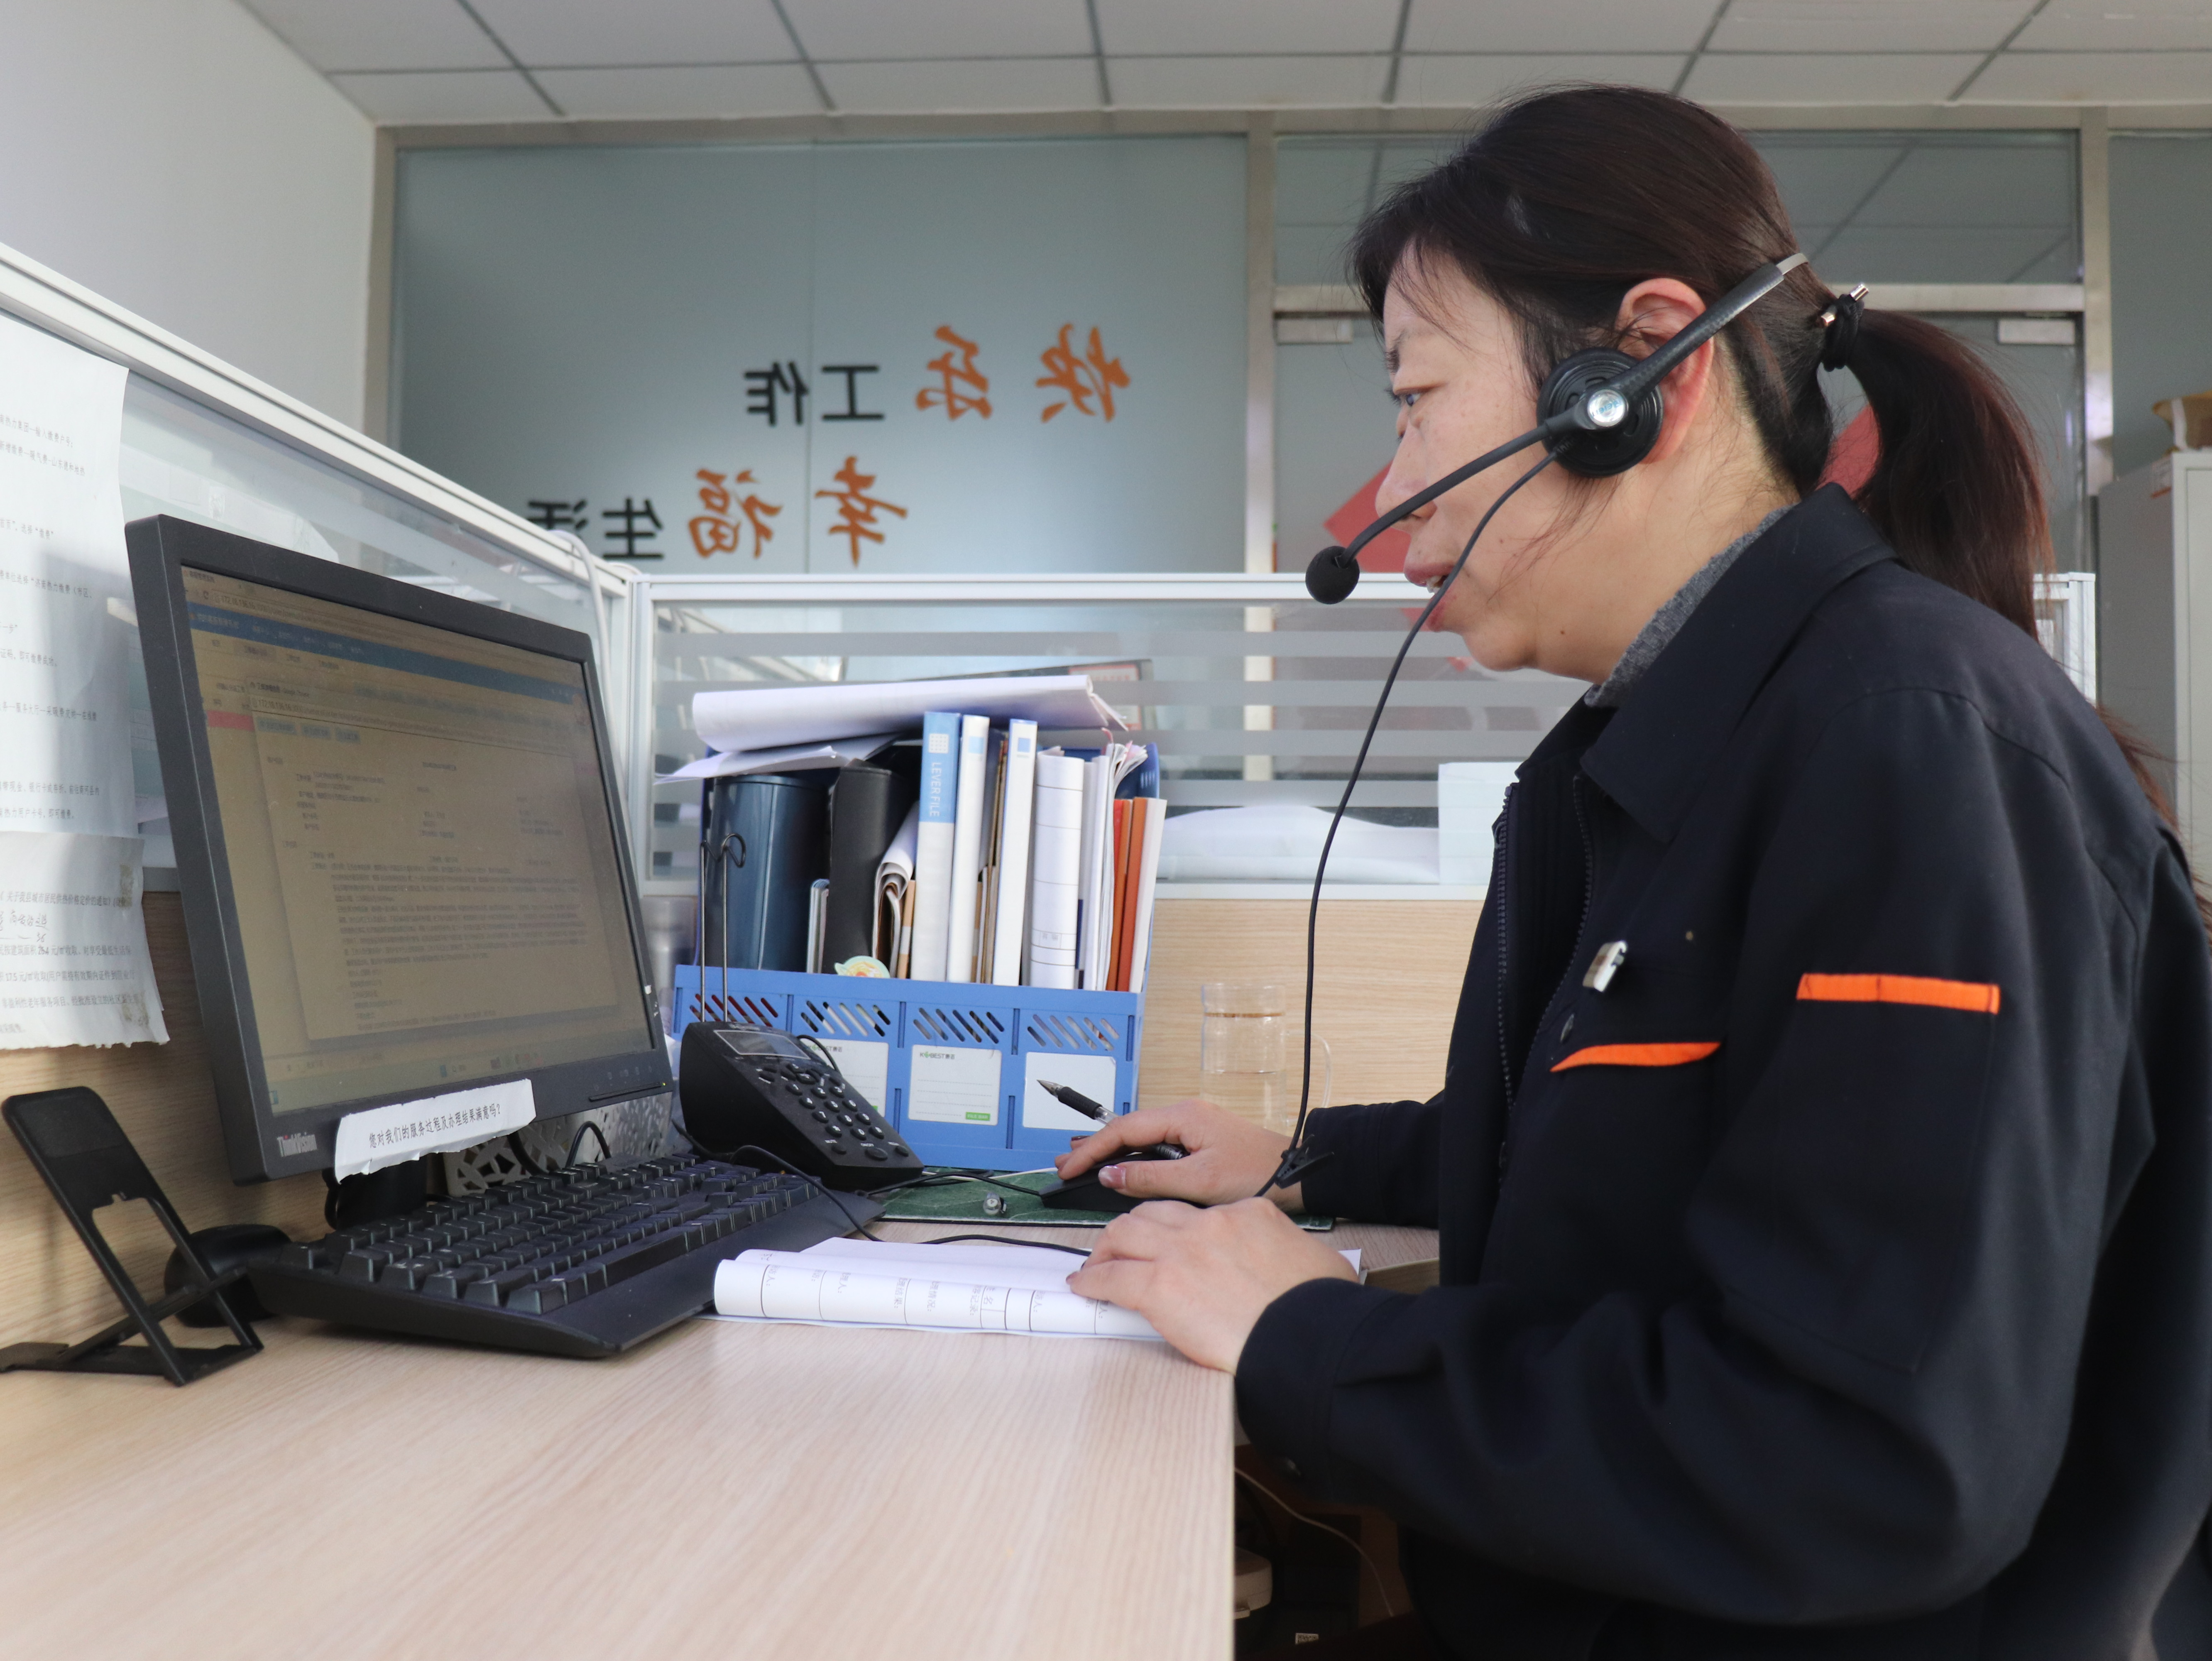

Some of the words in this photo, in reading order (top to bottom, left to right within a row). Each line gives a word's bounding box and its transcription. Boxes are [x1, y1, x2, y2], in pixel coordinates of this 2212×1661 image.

[931, 762, 942, 794] LEVER
[930, 796, 940, 817] FILE
[368, 1103, 502, 1149] 您对我们的服务过程及办理结果满意吗？
[926, 1280, 940, 1312] 理情况：
